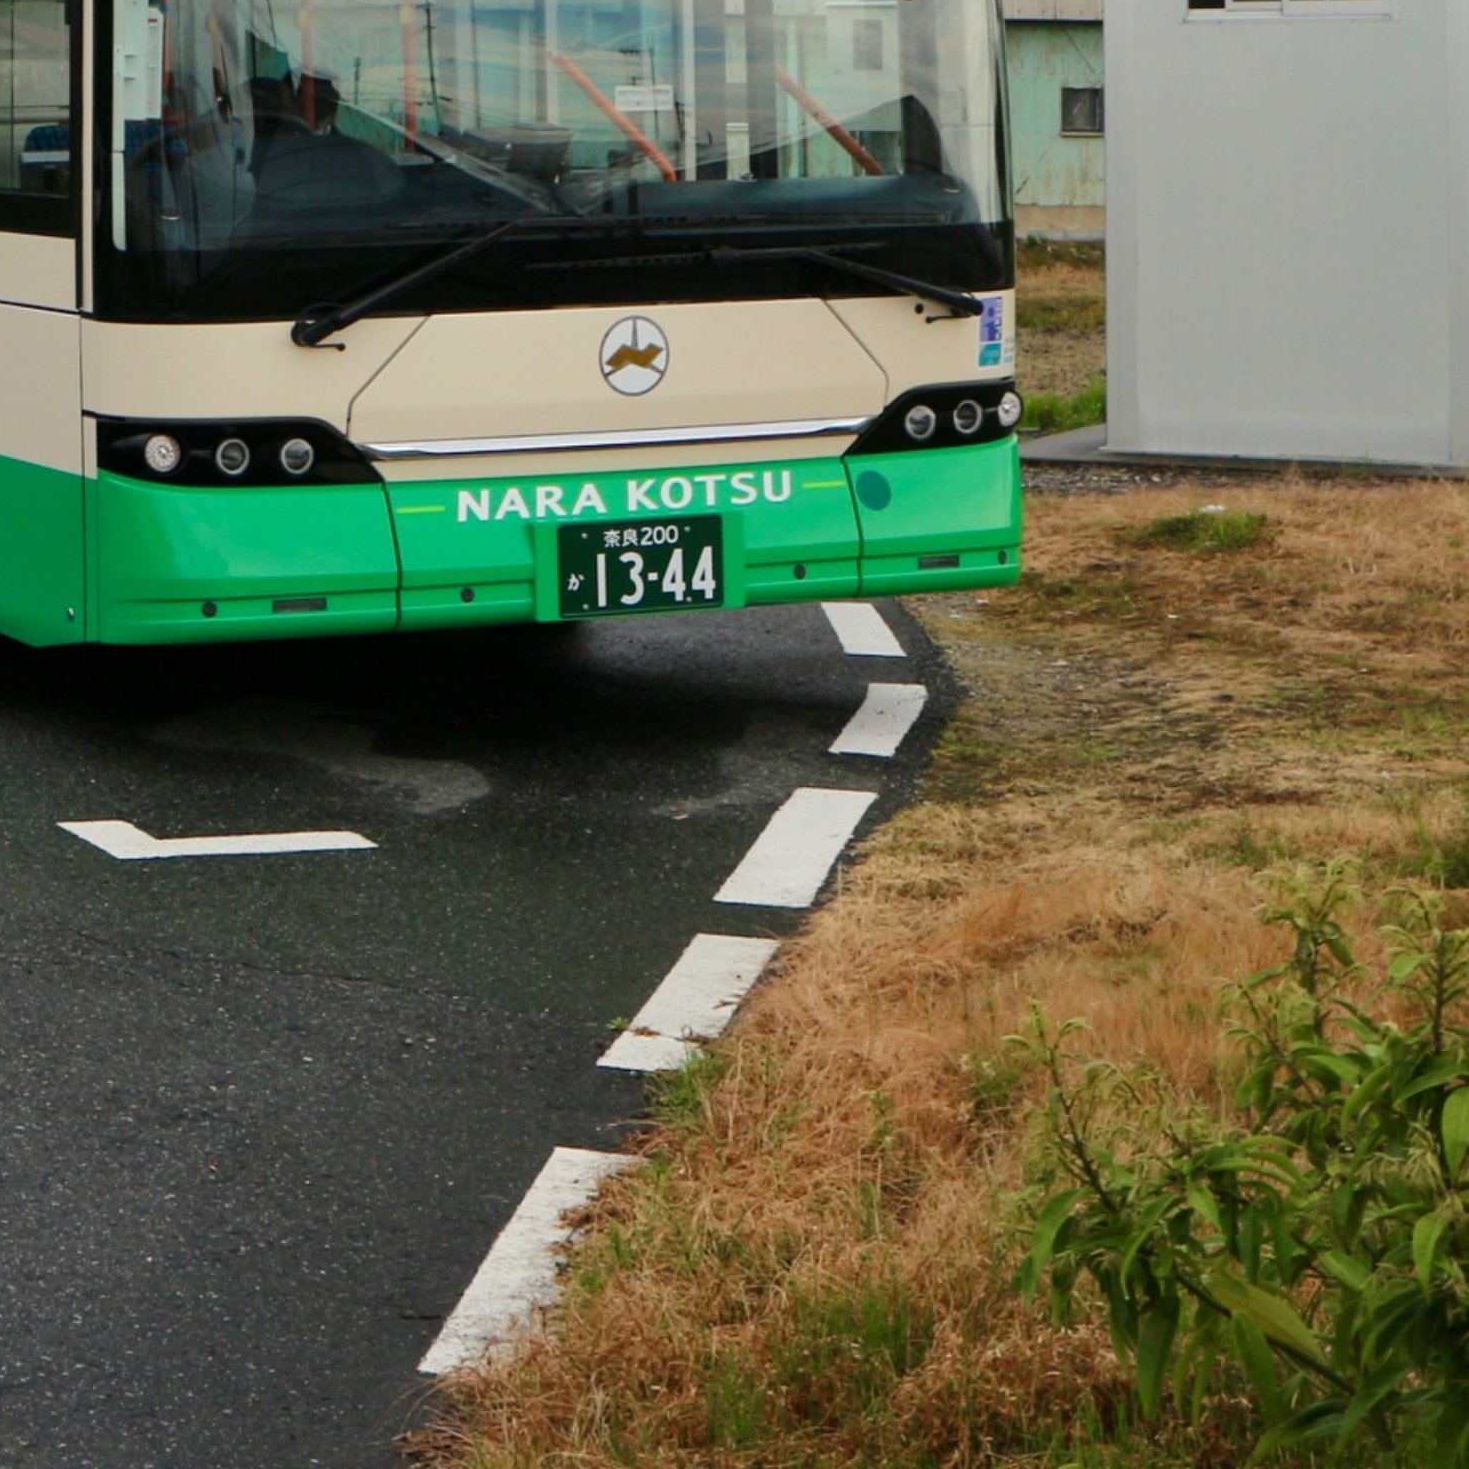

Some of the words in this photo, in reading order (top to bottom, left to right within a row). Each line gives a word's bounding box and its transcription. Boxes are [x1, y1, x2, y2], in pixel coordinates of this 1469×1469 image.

[458, 484, 607, 522] NARA
[627, 470, 792, 512] KOTSU
[596, 545, 716, 608] 13-44
